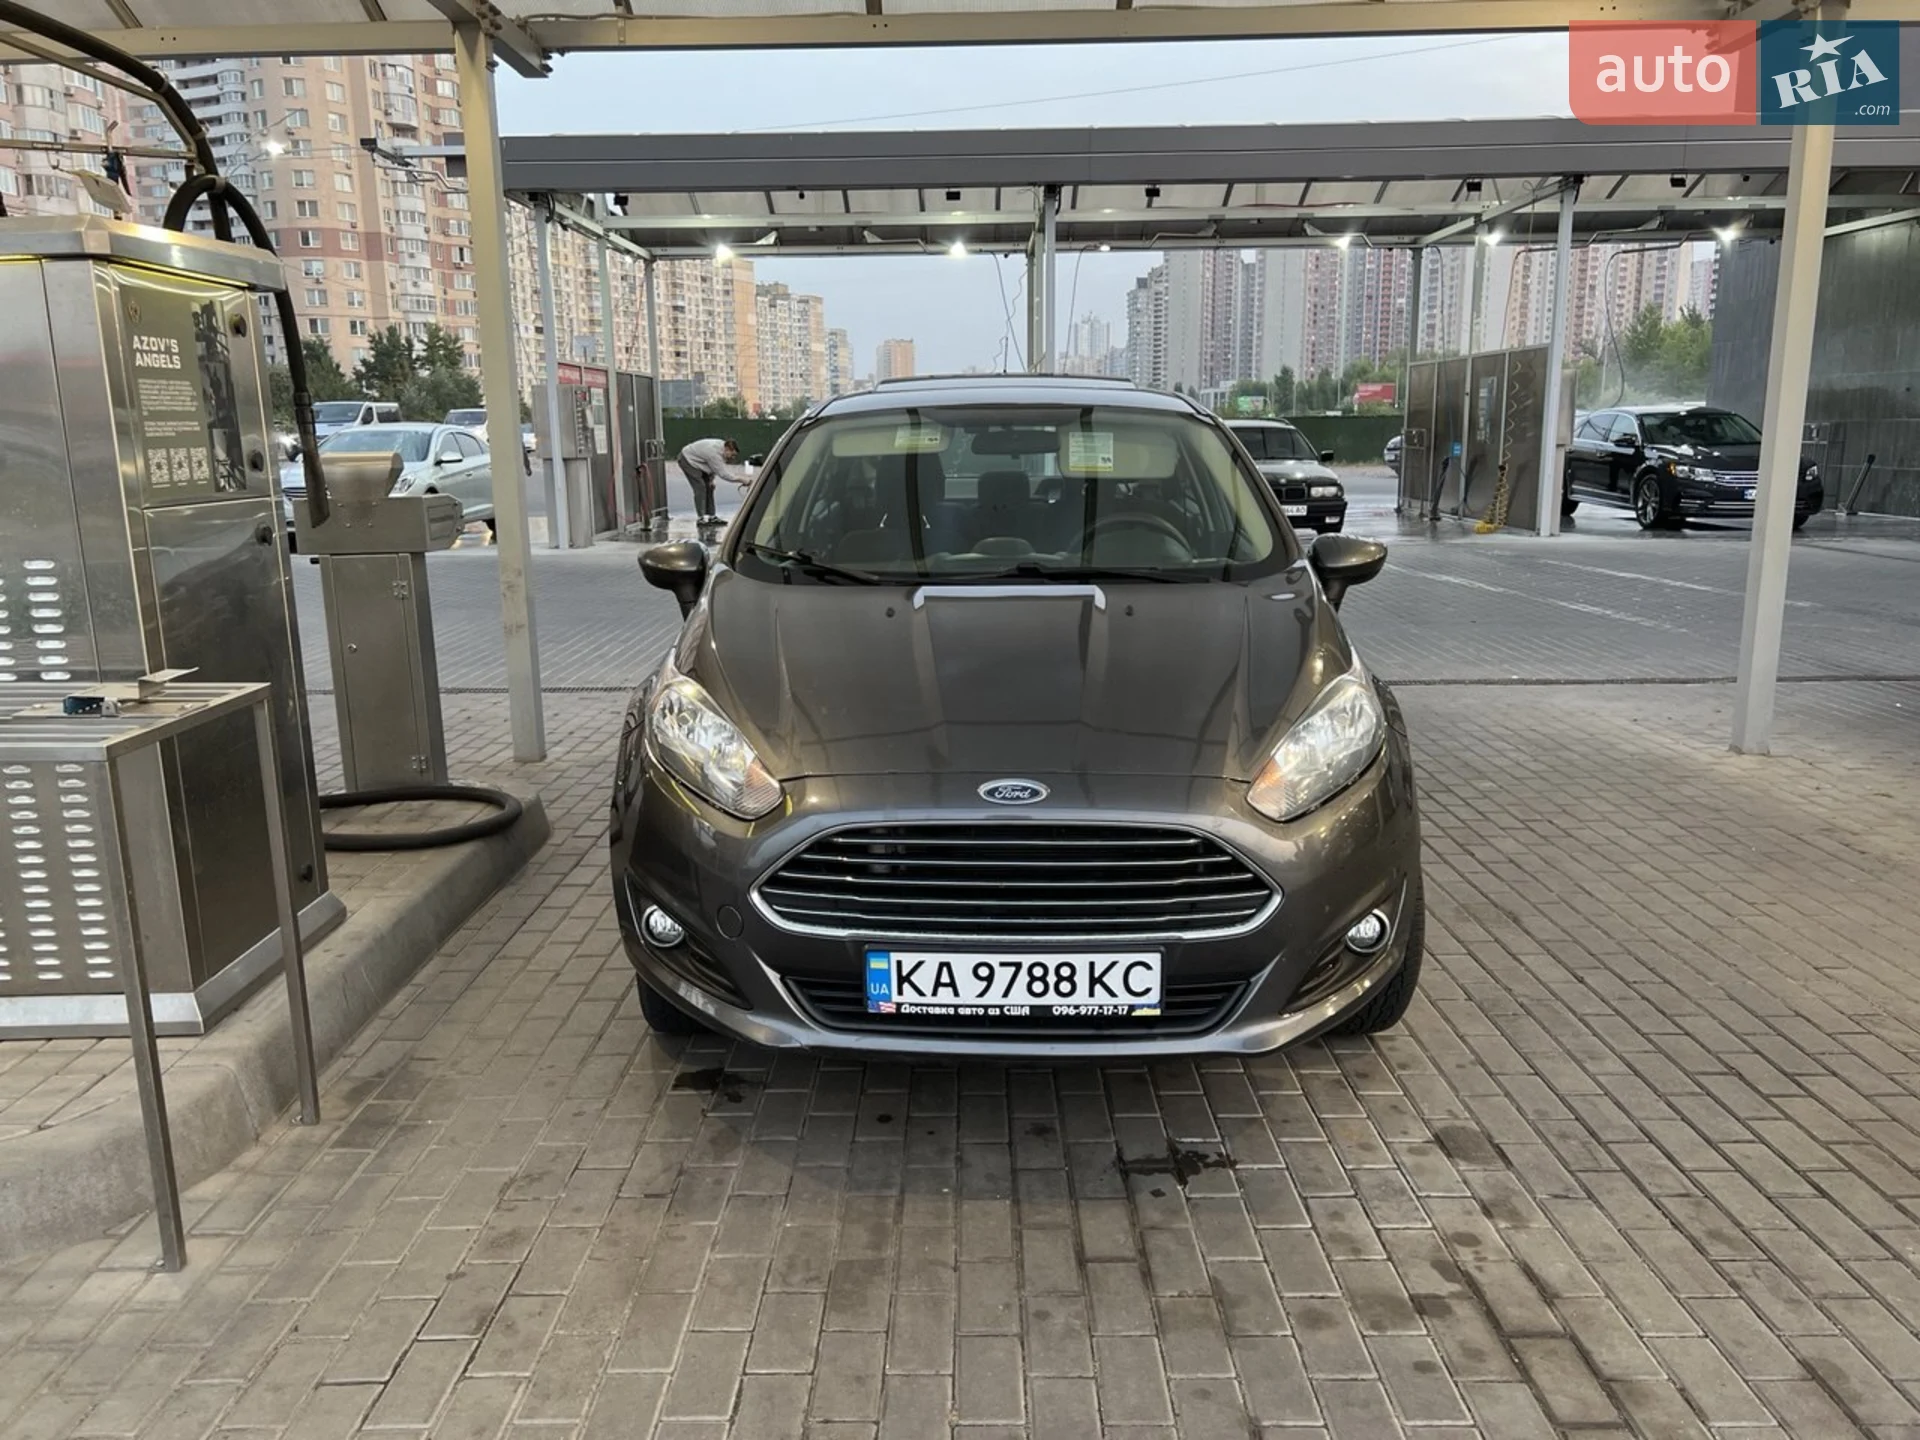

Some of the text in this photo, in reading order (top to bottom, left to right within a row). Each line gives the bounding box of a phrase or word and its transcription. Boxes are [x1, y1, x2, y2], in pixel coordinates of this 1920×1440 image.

[133, 335, 179, 353] AZOV'S
[135, 352, 181, 369] ANGELS
[994, 786, 1032, 799] Ford
[871, 982, 889, 995] UA
[901, 1004, 955, 1014] Доставка
[957, 1006, 985, 1015] авто
[1003, 1006, 1030, 1016] США
[1052, 1006, 1128, 1016] 096-977-17-17
